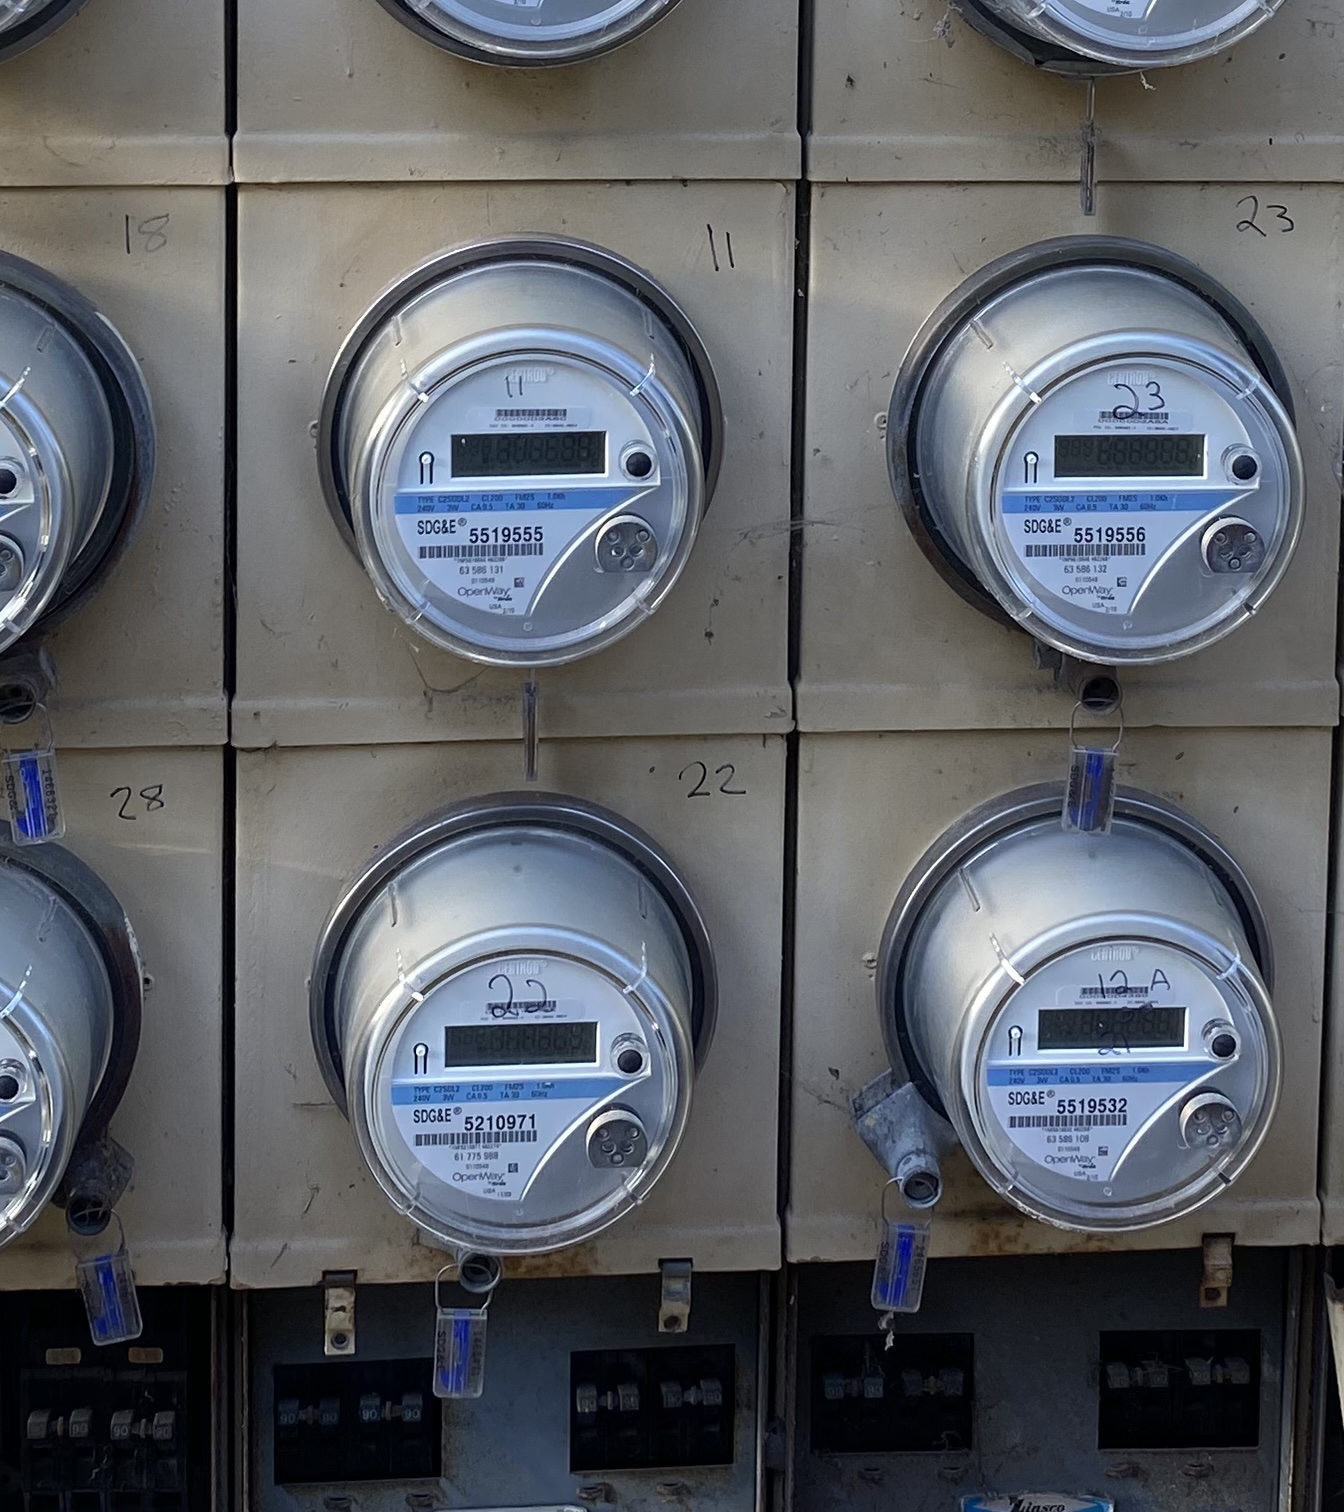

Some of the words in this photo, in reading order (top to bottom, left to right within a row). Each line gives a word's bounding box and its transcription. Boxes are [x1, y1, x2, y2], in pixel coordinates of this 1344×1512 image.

[1236, 195, 1294, 238] 23
[125, 213, 169, 255] 18
[706, 223, 735, 272] 11
[505, 375, 523, 398] 11
[1112, 381, 1165, 420] 23
[469, 526, 544, 544] 5519555
[1073, 527, 1146, 543] 5519556
[459, 565, 470, 575] 63
[471, 565, 487, 575] 586
[489, 565, 504, 575] 131
[457, 587, 512, 597] OpenWay
[1061, 585, 1113, 596] OpenWay
[678, 760, 747, 798] 22
[110, 784, 164, 820] 28
[488, 973, 555, 1018] 22
[1056, 1098, 1128, 1115] 5519532
[464, 1113, 537, 1132] 5210971
[1044, 1154, 1097, 1166] OpenWay
[452, 1172, 505, 1184] OpenWay
